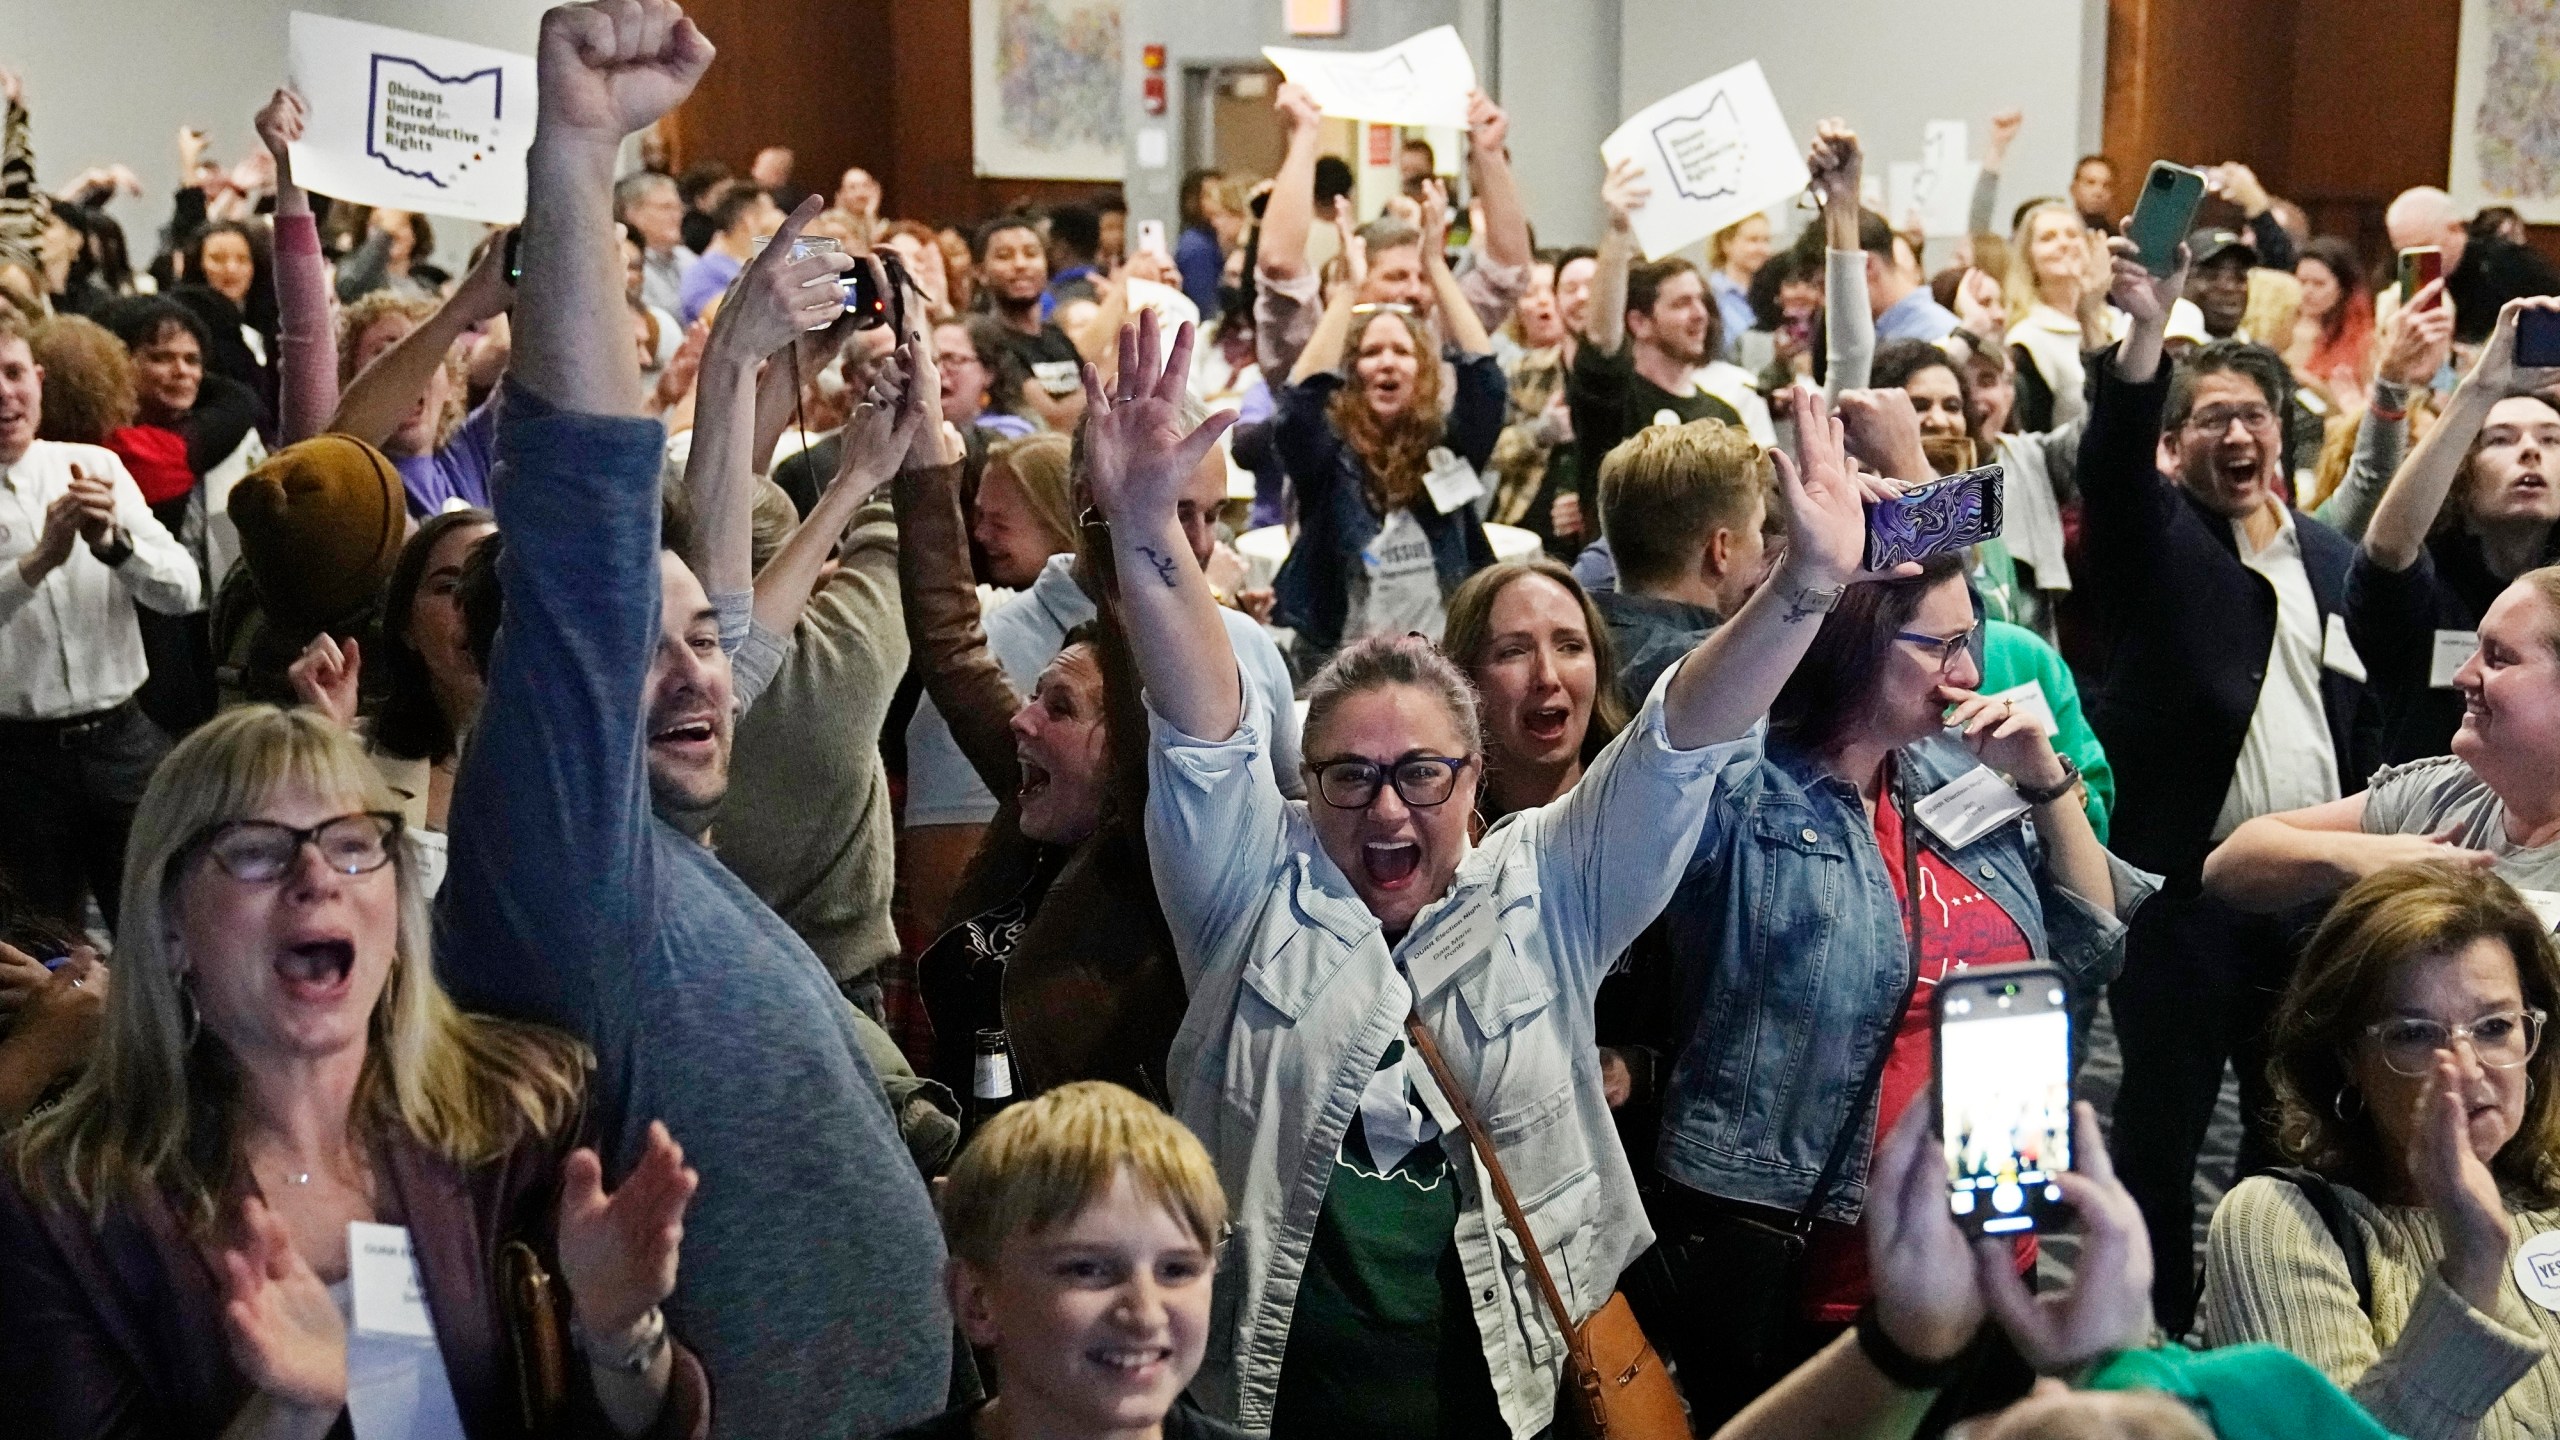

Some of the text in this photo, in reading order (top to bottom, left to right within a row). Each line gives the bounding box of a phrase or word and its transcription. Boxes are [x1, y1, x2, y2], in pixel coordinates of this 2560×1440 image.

[387, 80, 443, 104] Ohioans
[387, 98, 433, 119] United
[386, 115, 480, 143] Reproductive
[386, 131, 433, 152] Rights
[1413, 902, 1482, 960] OURR Election Night
